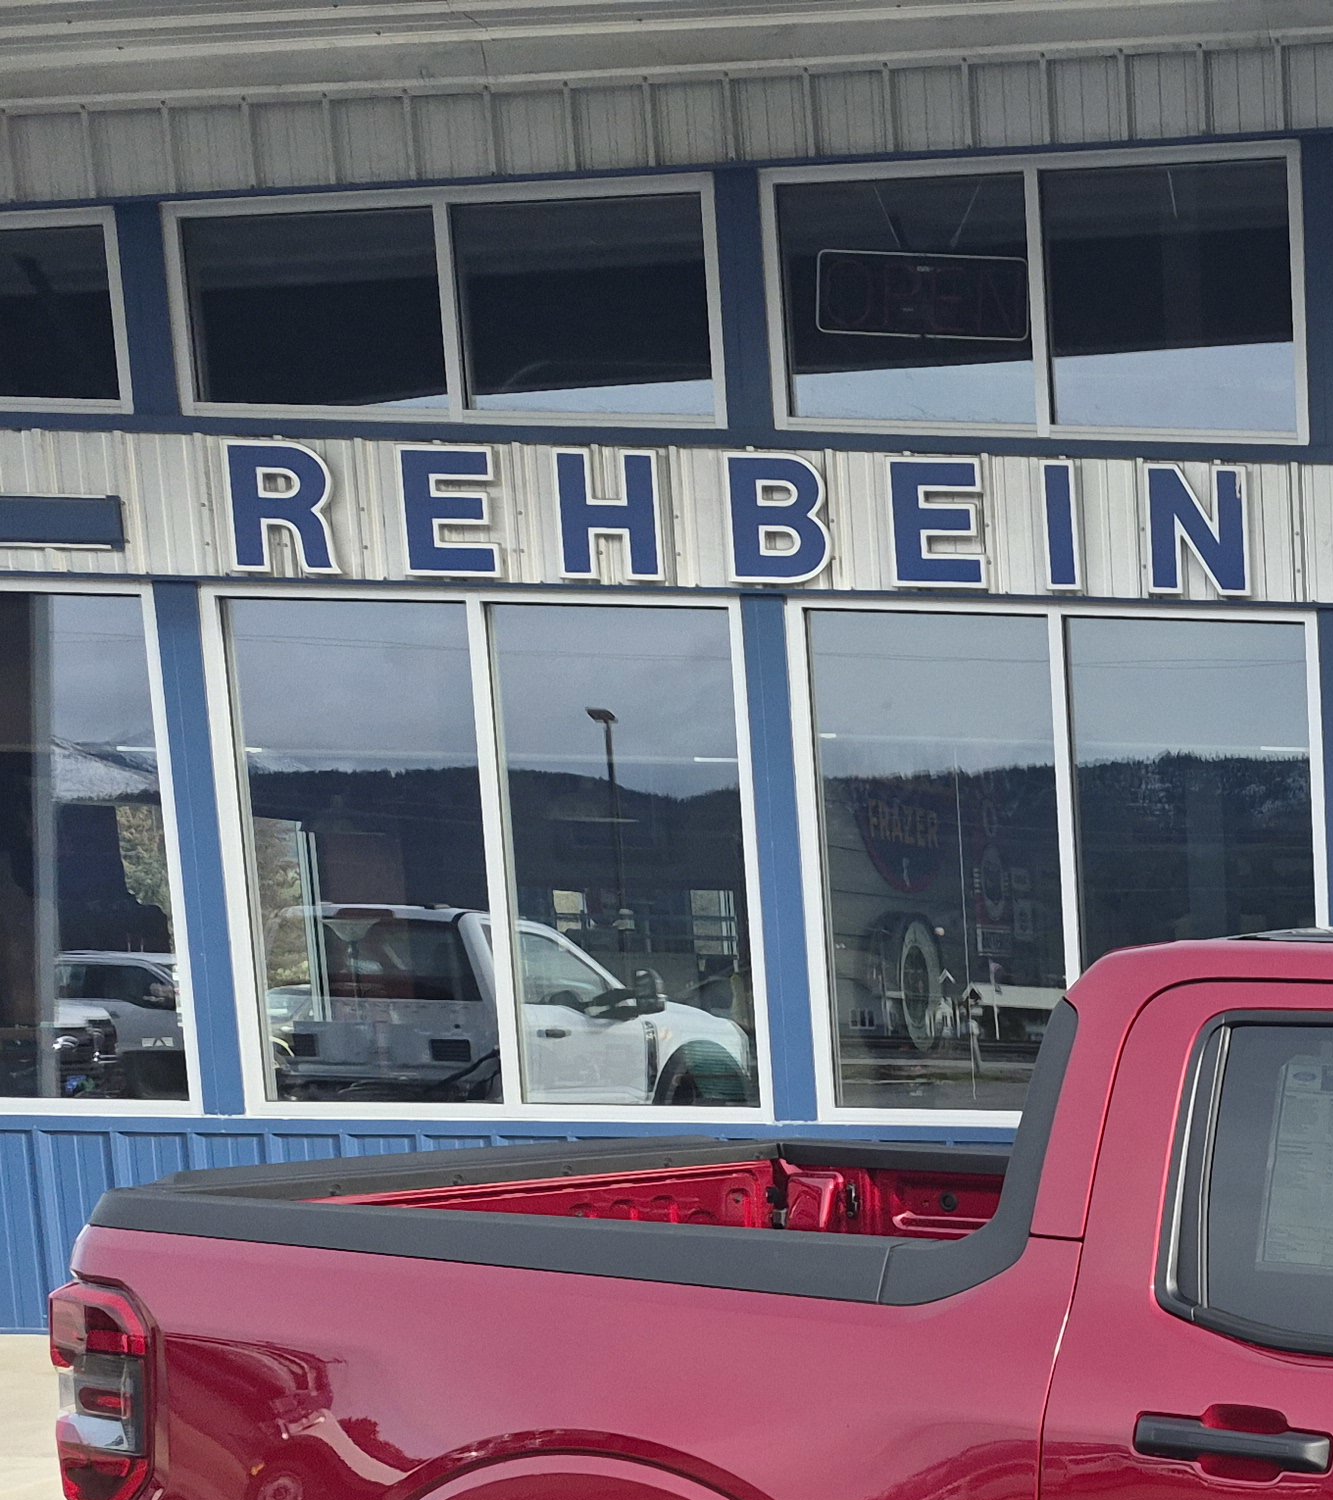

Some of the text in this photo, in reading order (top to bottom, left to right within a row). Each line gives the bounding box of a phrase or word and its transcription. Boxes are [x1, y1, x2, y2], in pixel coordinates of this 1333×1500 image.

[827, 259, 1021, 334] OPEN
[222, 438, 1252, 598] REHBEIN
[867, 799, 940, 849] FRAZER
